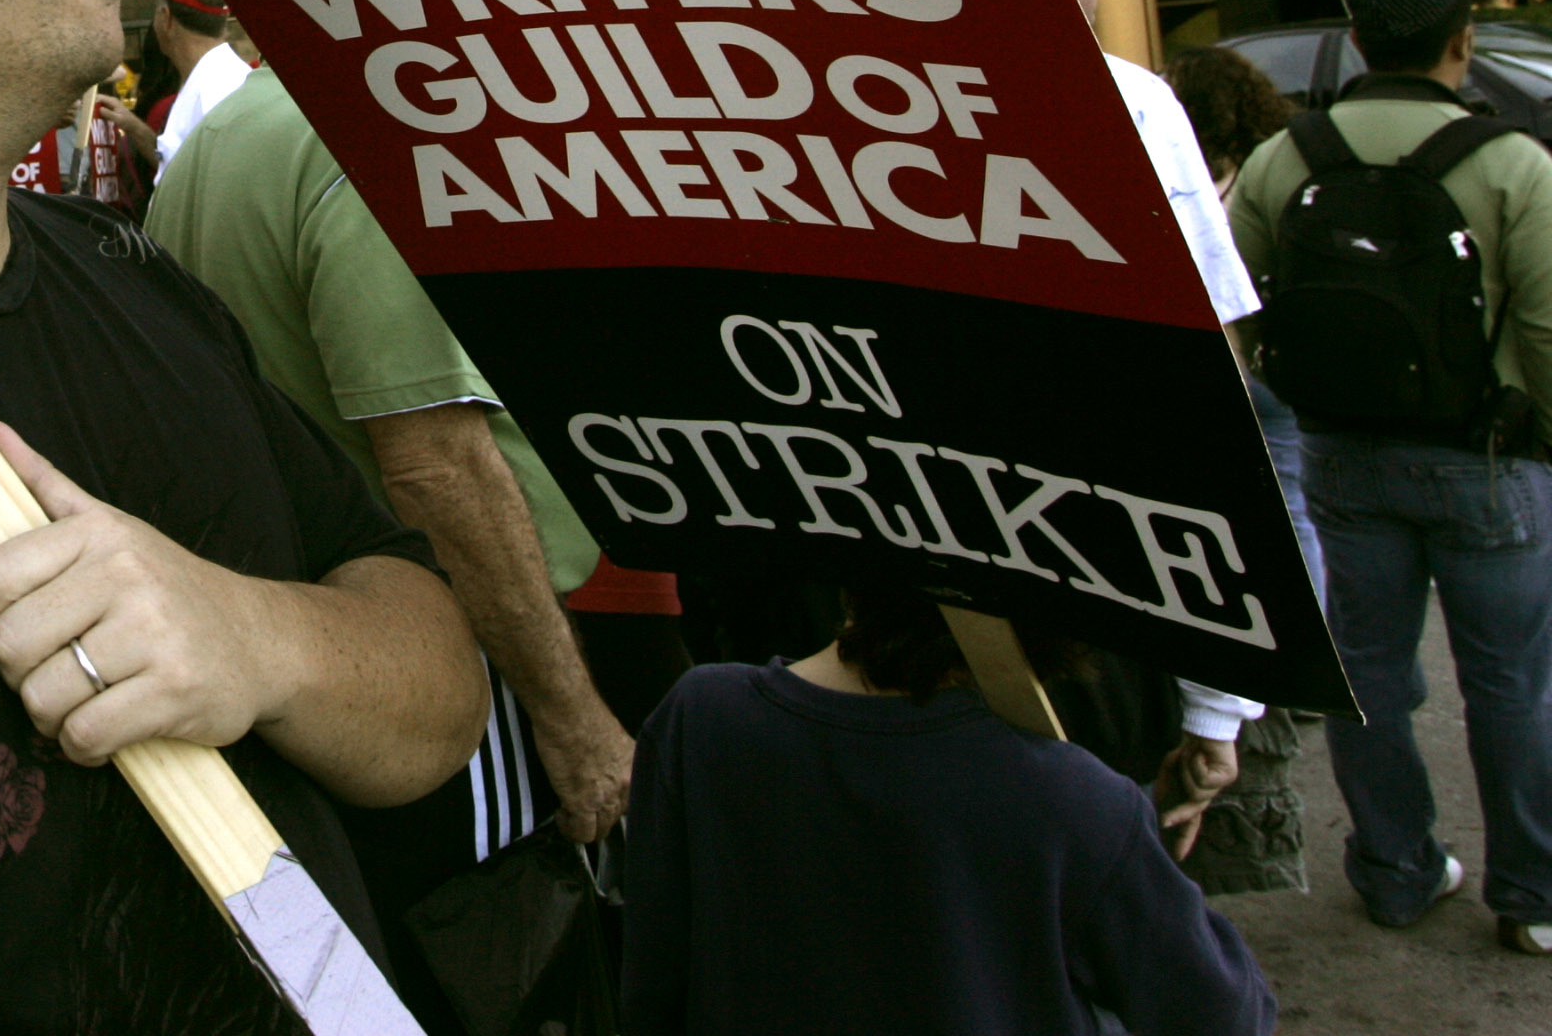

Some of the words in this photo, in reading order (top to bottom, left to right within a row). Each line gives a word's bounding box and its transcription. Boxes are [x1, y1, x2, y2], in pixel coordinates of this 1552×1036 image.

[363, 20, 814, 134] GUILD
[826, 54, 999, 139] OF
[12, 162, 40, 183] OF
[411, 130, 1127, 265] AMERICA
[720, 314, 903, 419] ON
[567, 412, 1277, 652] STRIKE
